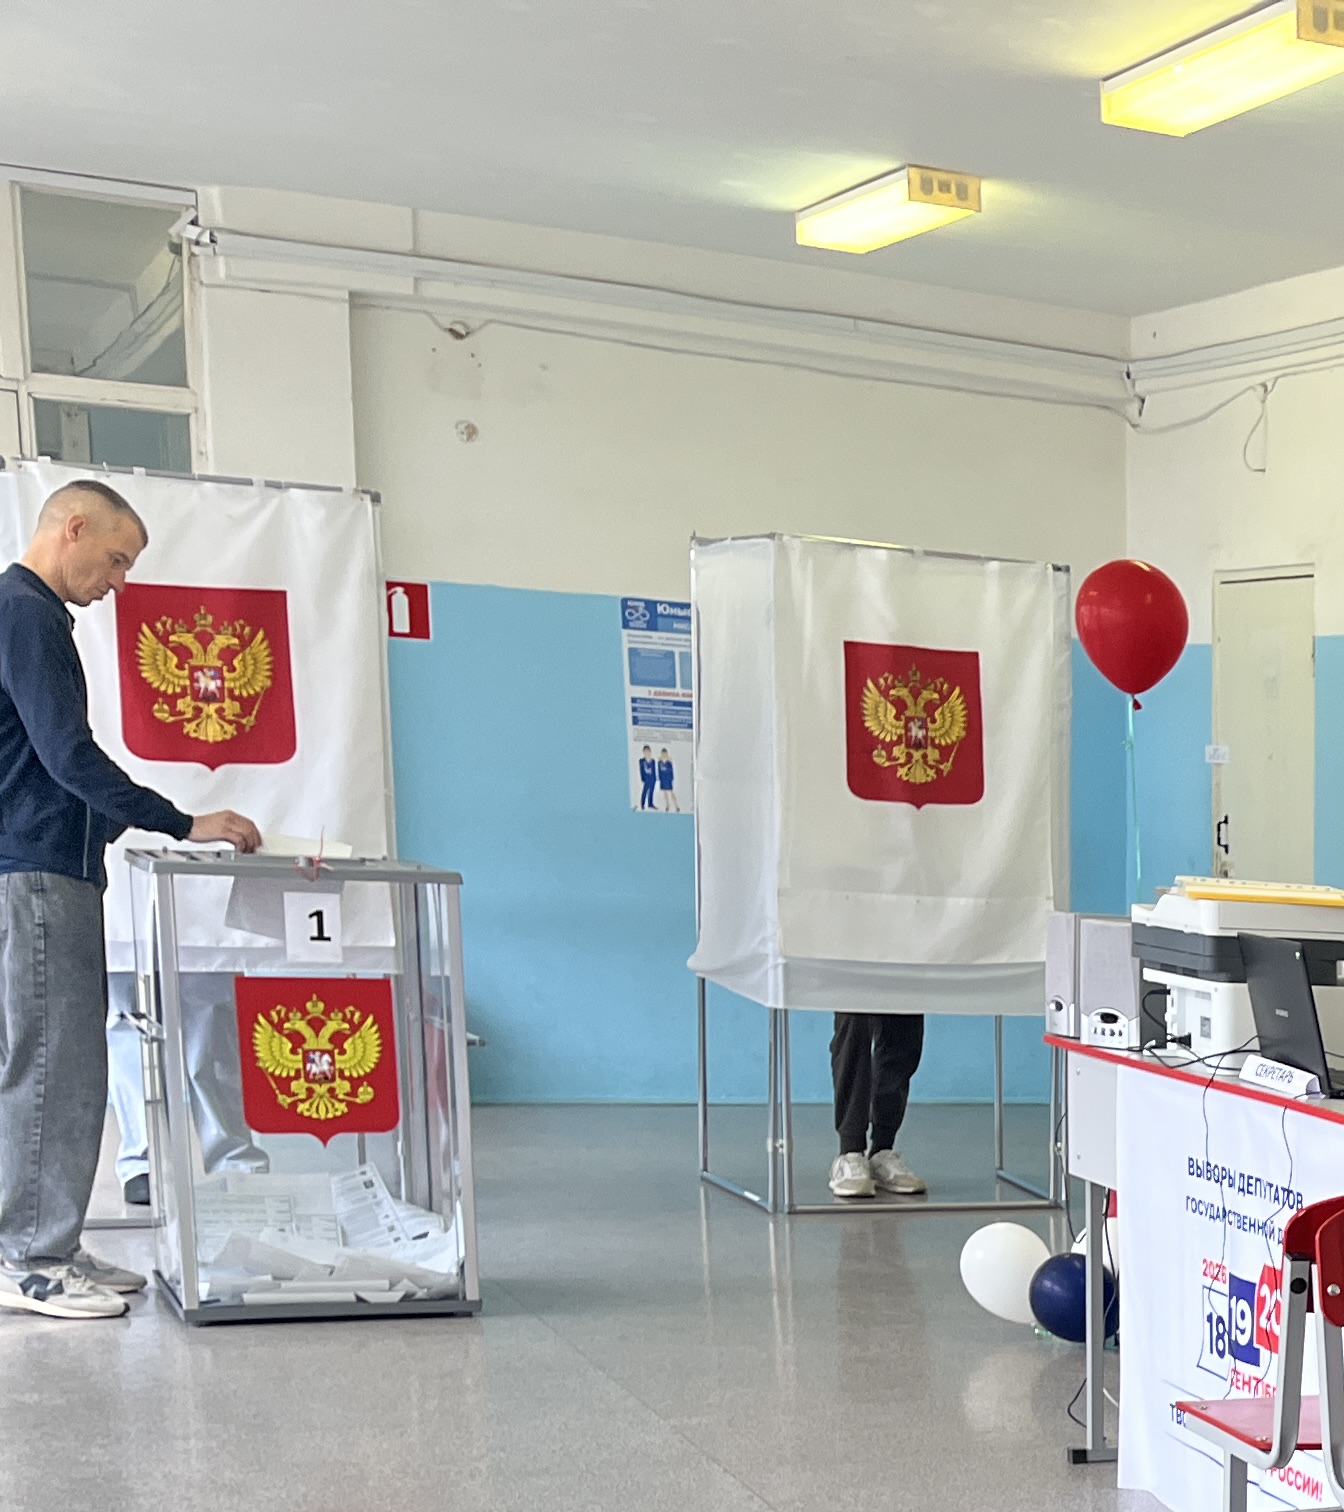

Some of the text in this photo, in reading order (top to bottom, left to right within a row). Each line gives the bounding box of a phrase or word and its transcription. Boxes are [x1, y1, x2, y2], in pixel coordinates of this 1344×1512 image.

[309, 909, 332, 942] 1
[1255, 1063, 1294, 1084] СЕКРЕТАРЬ
[1188, 1156, 1303, 1212] ВЫБОРЫ ДЕПУТАТОВ
[1207, 1311, 1226, 1359] 18
[1230, 1295, 1253, 1346] 19
